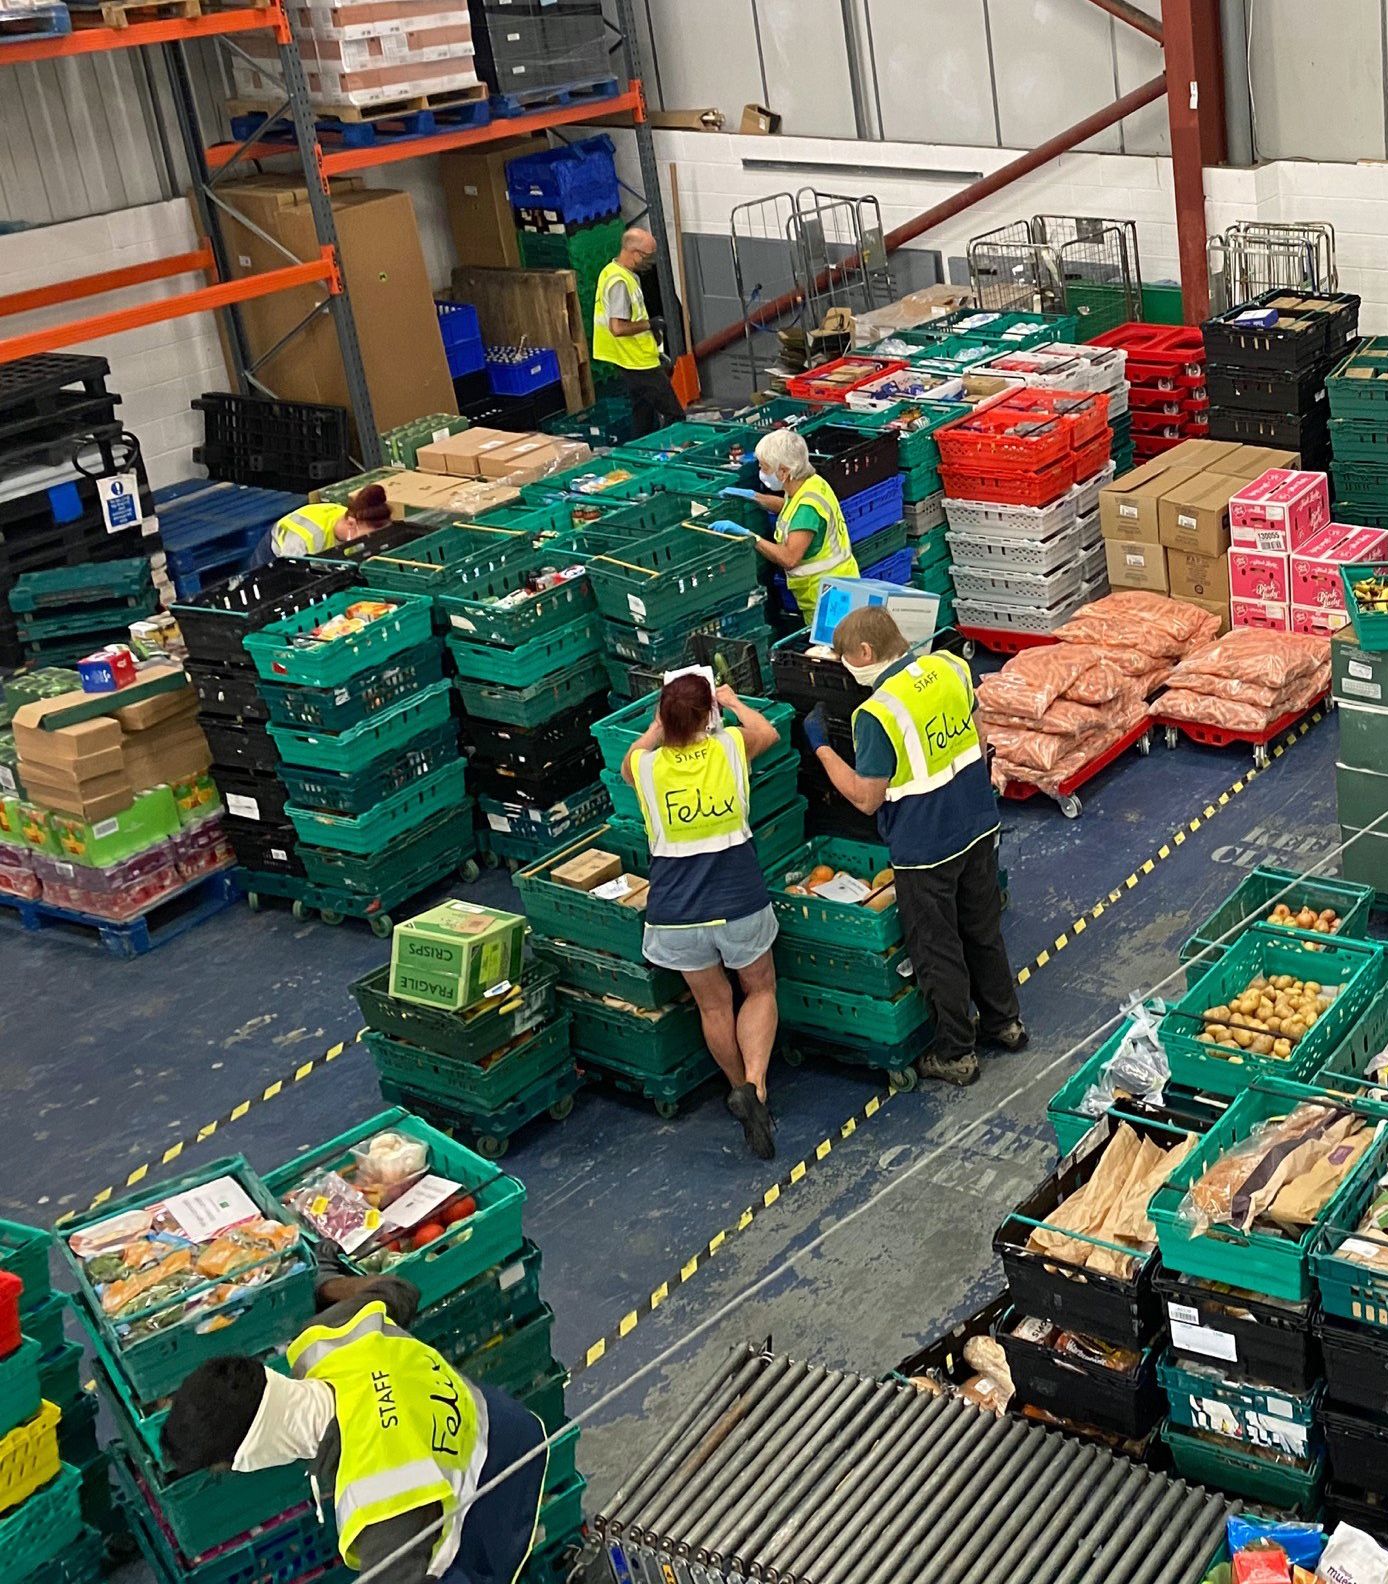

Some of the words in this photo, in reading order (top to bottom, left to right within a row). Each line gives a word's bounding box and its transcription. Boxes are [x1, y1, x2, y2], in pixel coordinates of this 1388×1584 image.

[1257, 531, 1280, 540] 130055
[914, 671, 939, 692] STAFF
[925, 712, 972, 756] Felix
[675, 748, 708, 763] STAFF
[665, 788, 735, 825] Felix
[409, 943, 453, 962] CRISPS
[400, 976, 454, 999] FRAGILE
[371, 1370, 399, 1429] STAFF
